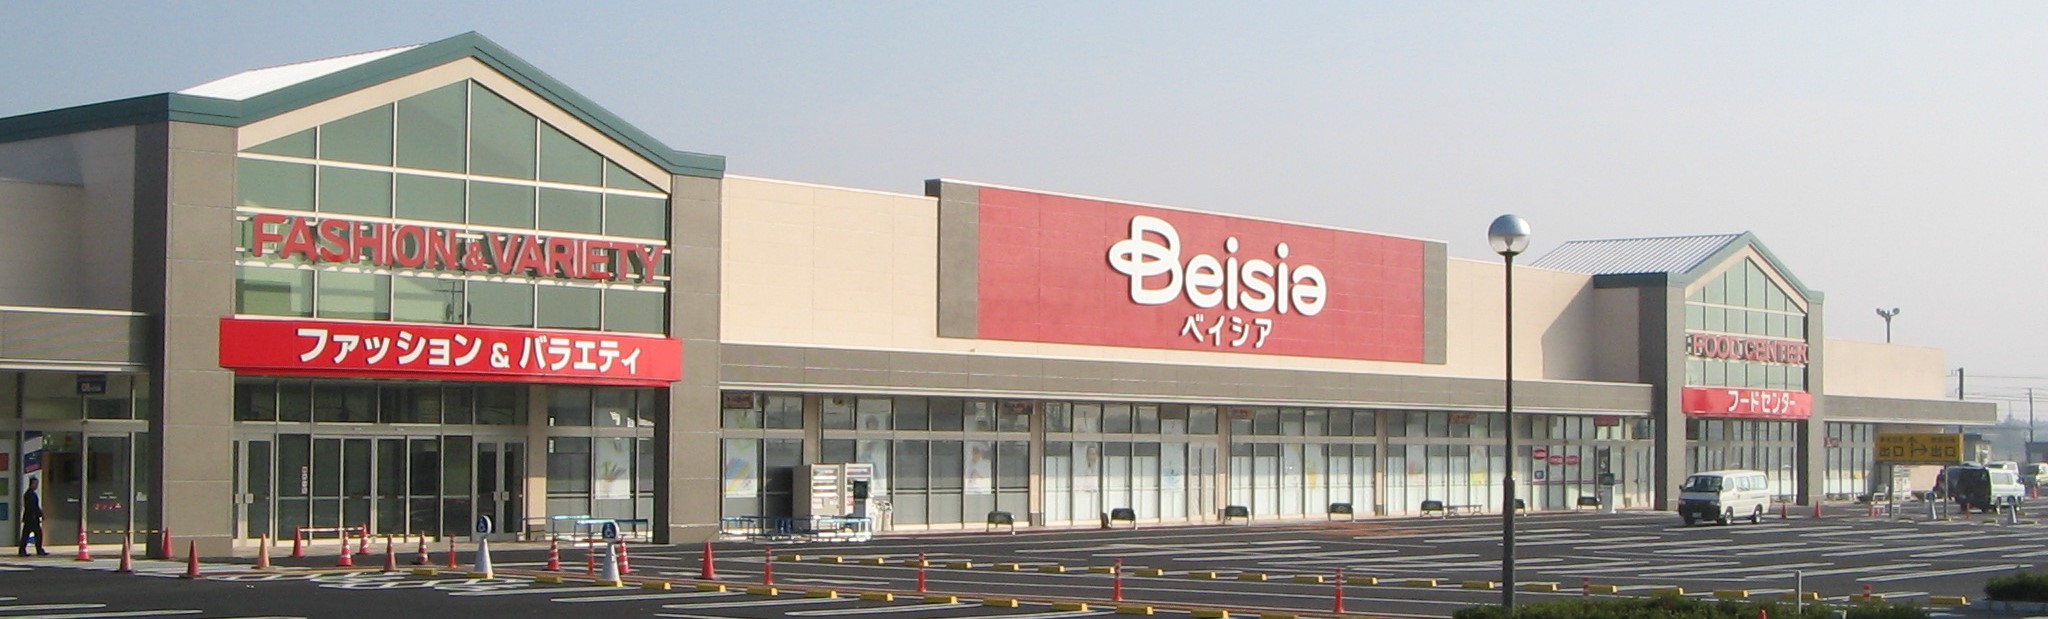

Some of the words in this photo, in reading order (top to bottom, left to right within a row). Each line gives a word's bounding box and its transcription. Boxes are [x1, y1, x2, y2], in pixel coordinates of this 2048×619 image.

[252, 213, 458, 271] FASHION
[463, 239, 488, 271] &
[489, 232, 664, 283] VARIETY
[1108, 215, 1328, 316] Beisia
[1180, 312, 1273, 349] ベイシア
[1692, 332, 1743, 360] FOOD
[1745, 338, 1808, 364] CENTER
[297, 327, 482, 367] ファッション
[490, 342, 511, 369] &
[519, 335, 641, 375] バラエティ
[1728, 390, 1796, 414] フードセンター
[1880, 445, 1904, 457] 出口
[1931, 445, 1957, 457] 出口
